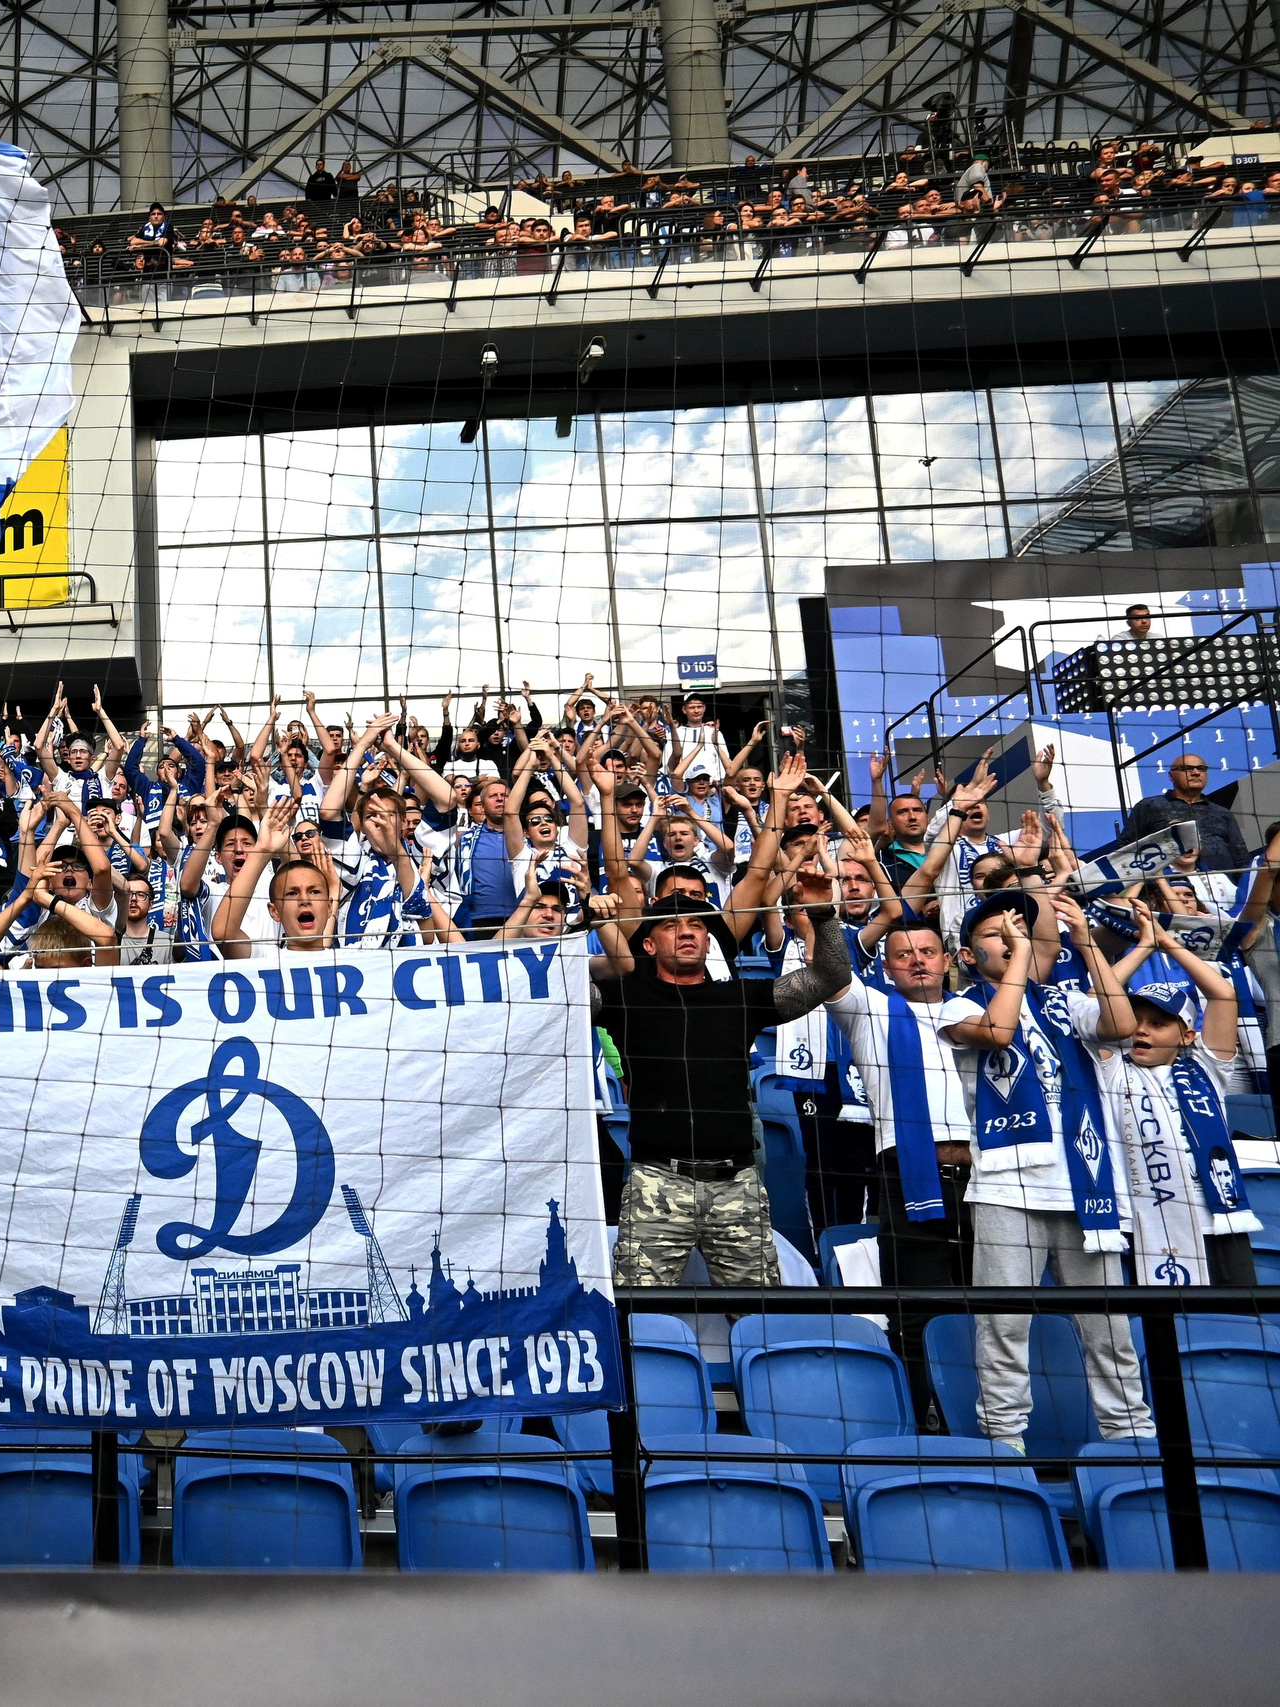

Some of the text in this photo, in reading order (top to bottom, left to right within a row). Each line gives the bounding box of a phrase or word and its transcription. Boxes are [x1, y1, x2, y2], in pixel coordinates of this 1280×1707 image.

[1235, 156, 1258, 165] D 307
[681, 660, 715, 673] D 105
[110, 975, 183, 1029] IS
[208, 965, 367, 1024] OUR
[393, 943, 559, 1011] CITY
[984, 1111, 1037, 1134] 1923
[1140, 1087, 1176, 1207] ОСКВА
[1084, 1198, 1113, 1214] 1923
[217, 1269, 274, 1280] ДИНАМО
[20, 1356, 137, 1418] PRIDE
[148, 1357, 198, 1417] OF
[210, 1348, 387, 1414] MOSCOW
[400, 1337, 516, 1405] SINCE
[523, 1330, 605, 1395] 1923
